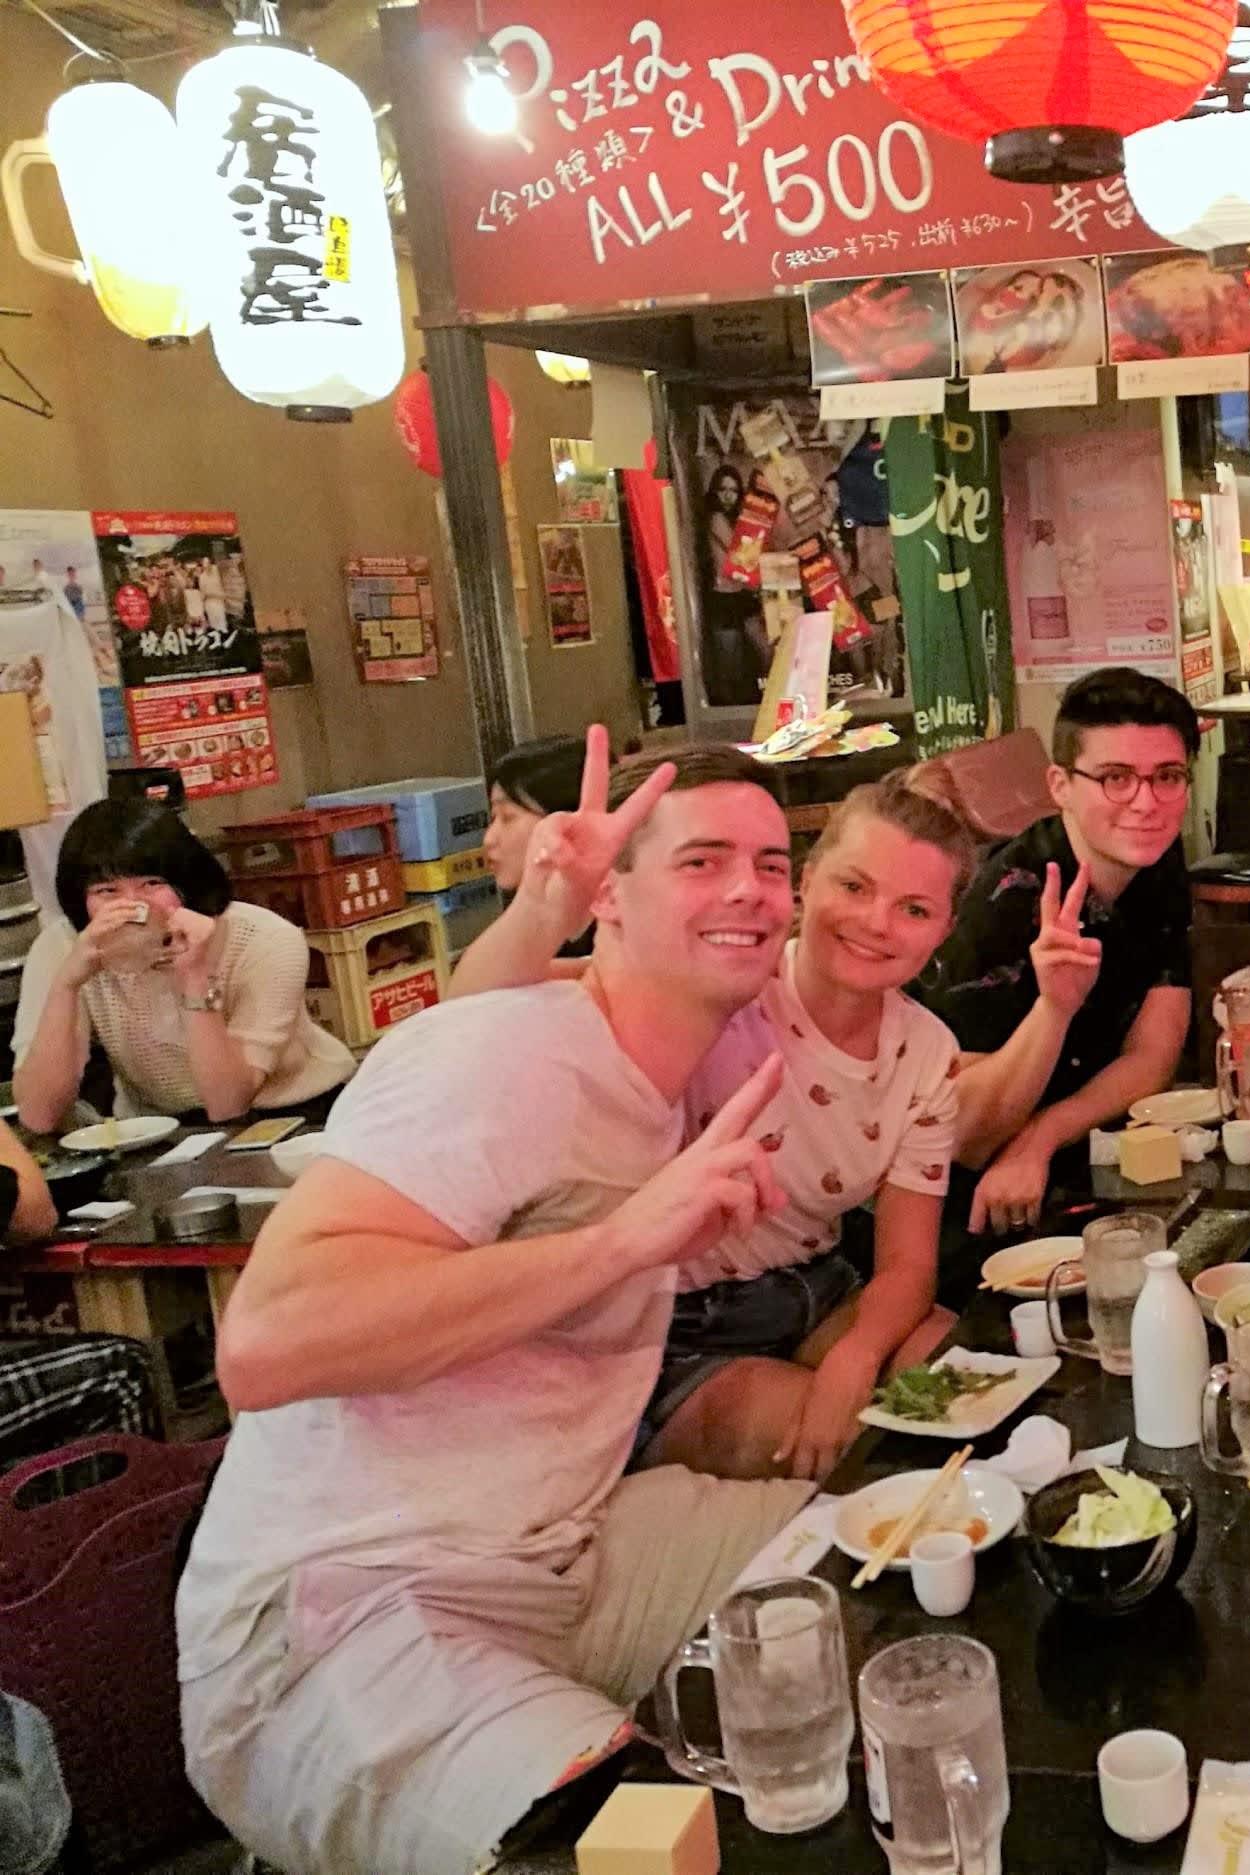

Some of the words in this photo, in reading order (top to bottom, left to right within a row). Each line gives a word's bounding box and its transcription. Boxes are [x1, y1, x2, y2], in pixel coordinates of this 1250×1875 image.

[666, 90, 706, 138] &
[709, 52, 871, 146] Drin
[216, 84, 362, 326] 居酒屋
[586, 171, 693, 265] ALL
